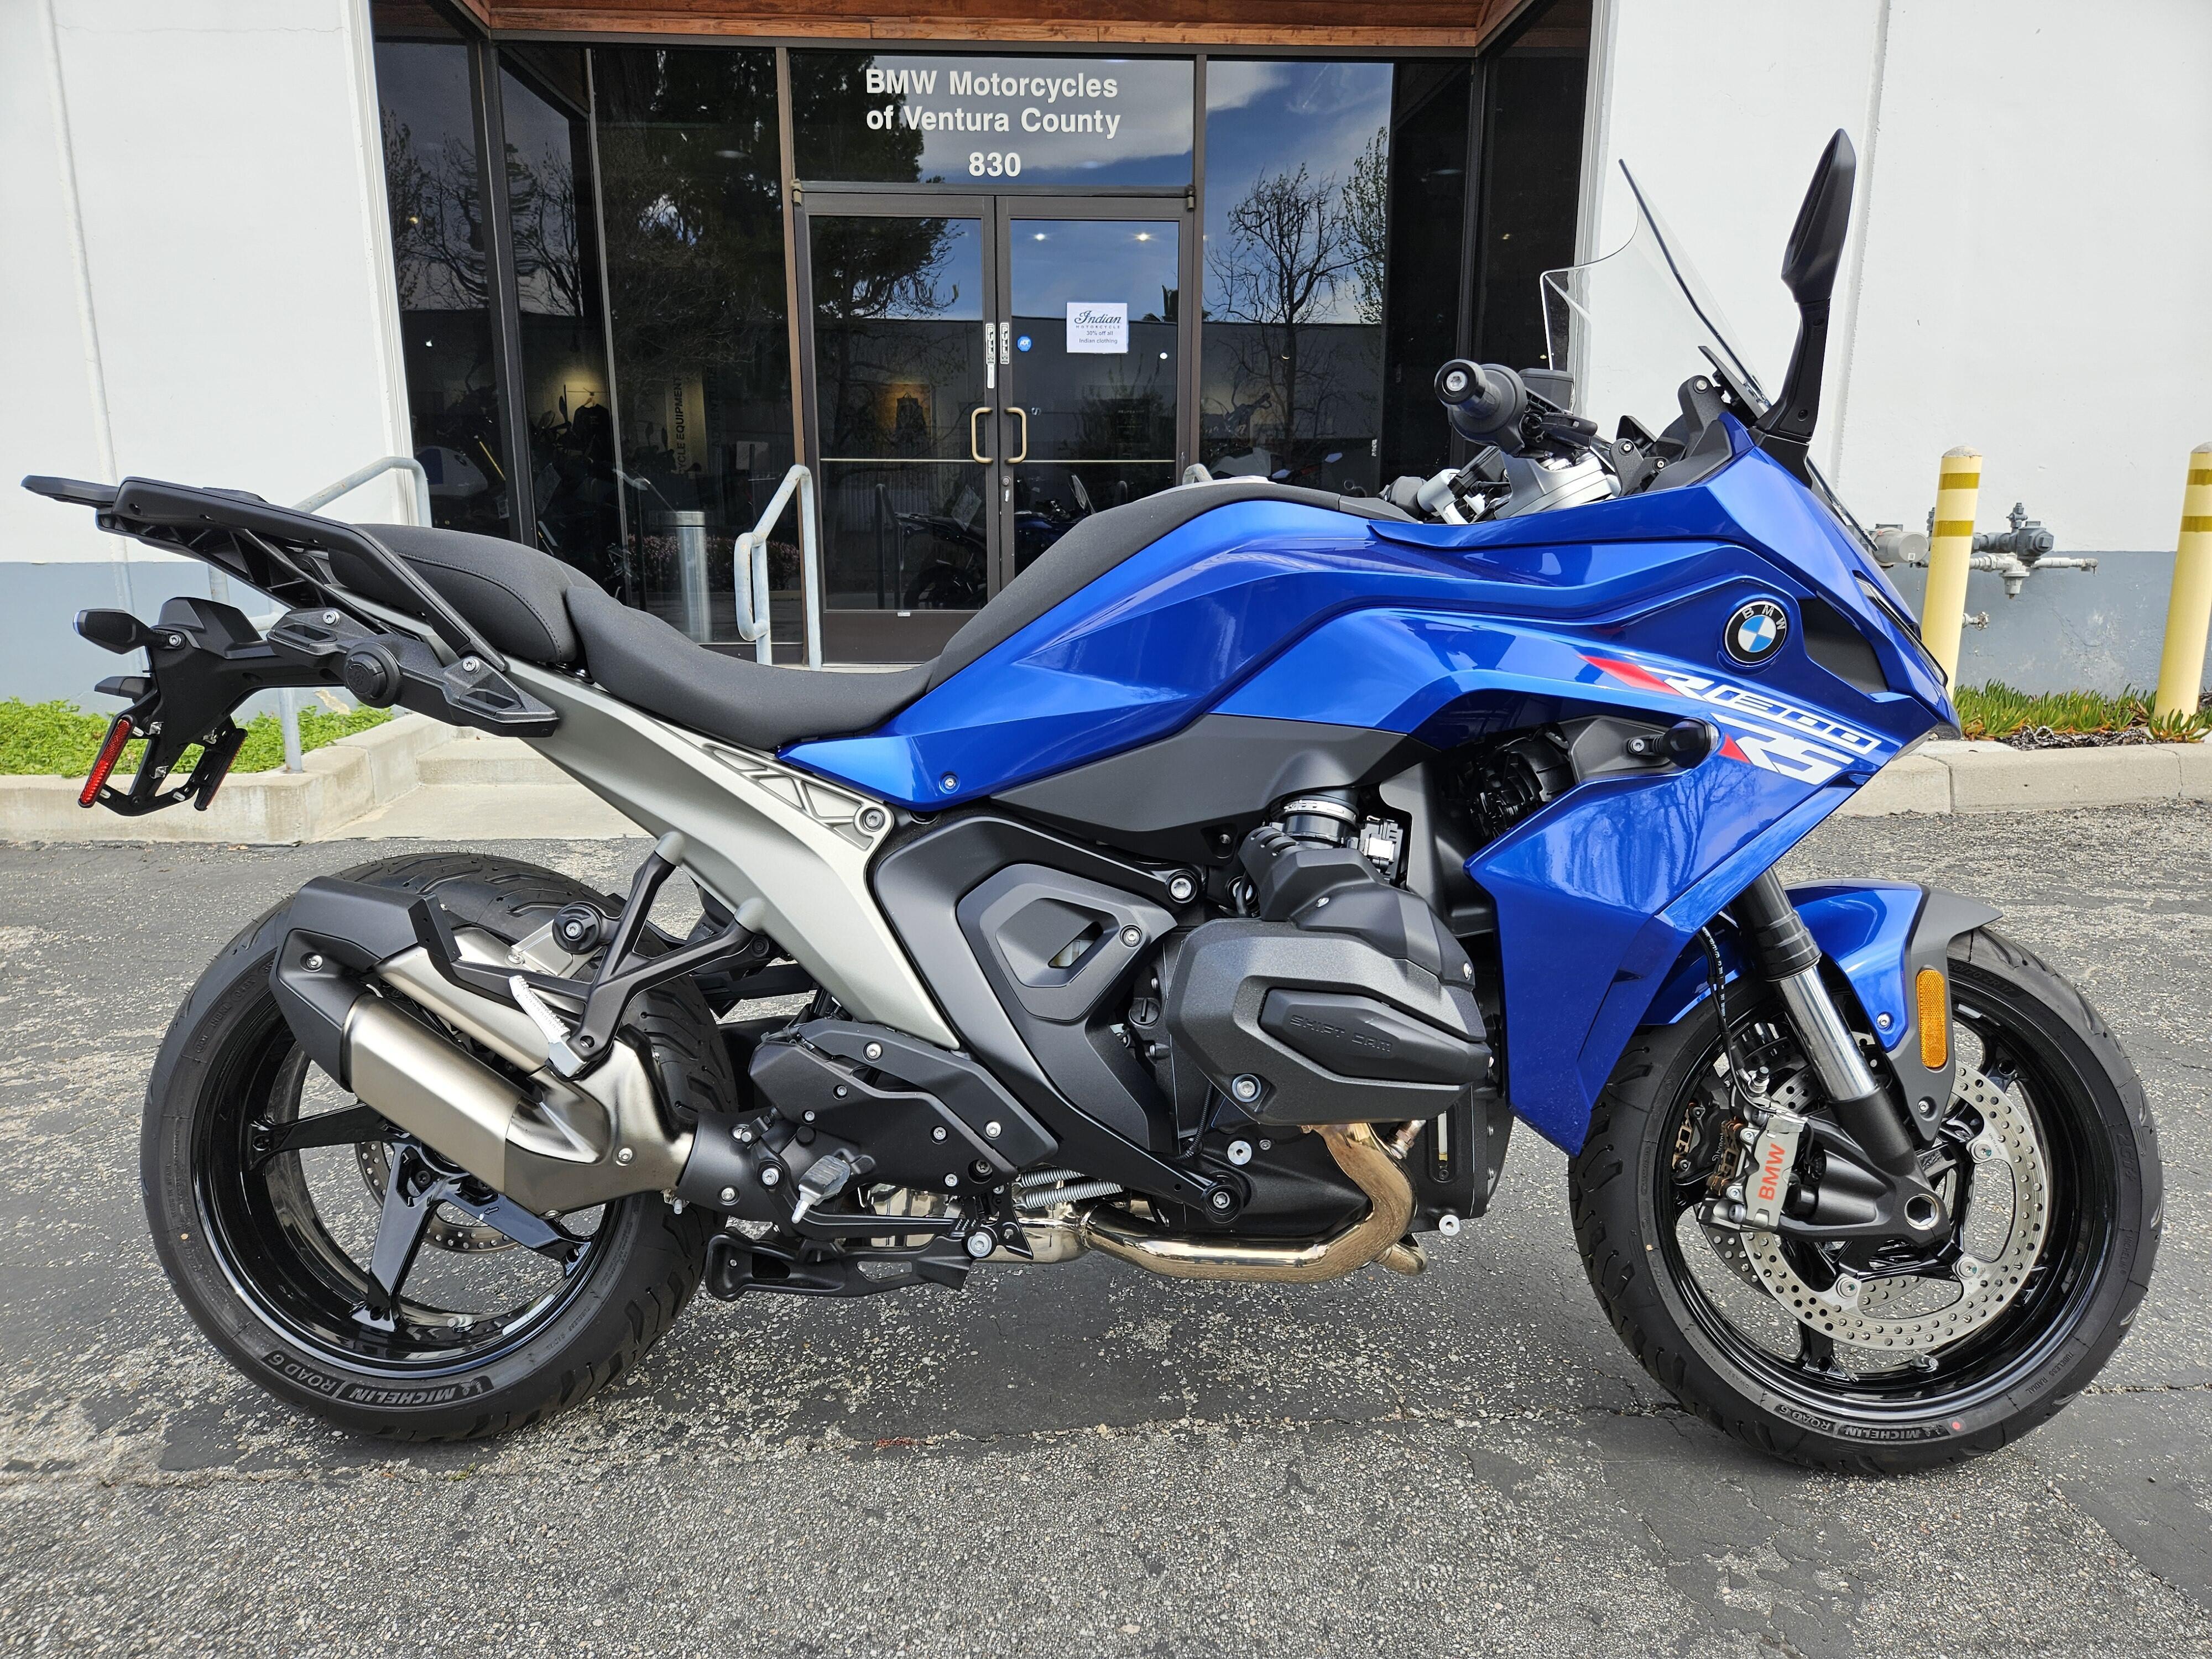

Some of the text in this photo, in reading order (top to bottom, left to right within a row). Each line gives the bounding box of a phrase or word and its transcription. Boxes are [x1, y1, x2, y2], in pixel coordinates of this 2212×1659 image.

[866, 69, 1118, 103] BMW Motorcycles
[866, 105, 1121, 139] of Ventura County
[968, 152, 1021, 177] 830
[1074, 310, 1121, 324] Indian
[672, 377, 685, 440] EQUIPMENT
[1742, 604, 1787, 630] BMW
[1290, 1014, 1345, 1038] SHIFT
[1757, 1143, 1786, 1201] BMW
[268, 1354, 456, 1404] MICHELIN ROAD 6
[1779, 1406, 1921, 1439] MICHELIN ROAD 6
